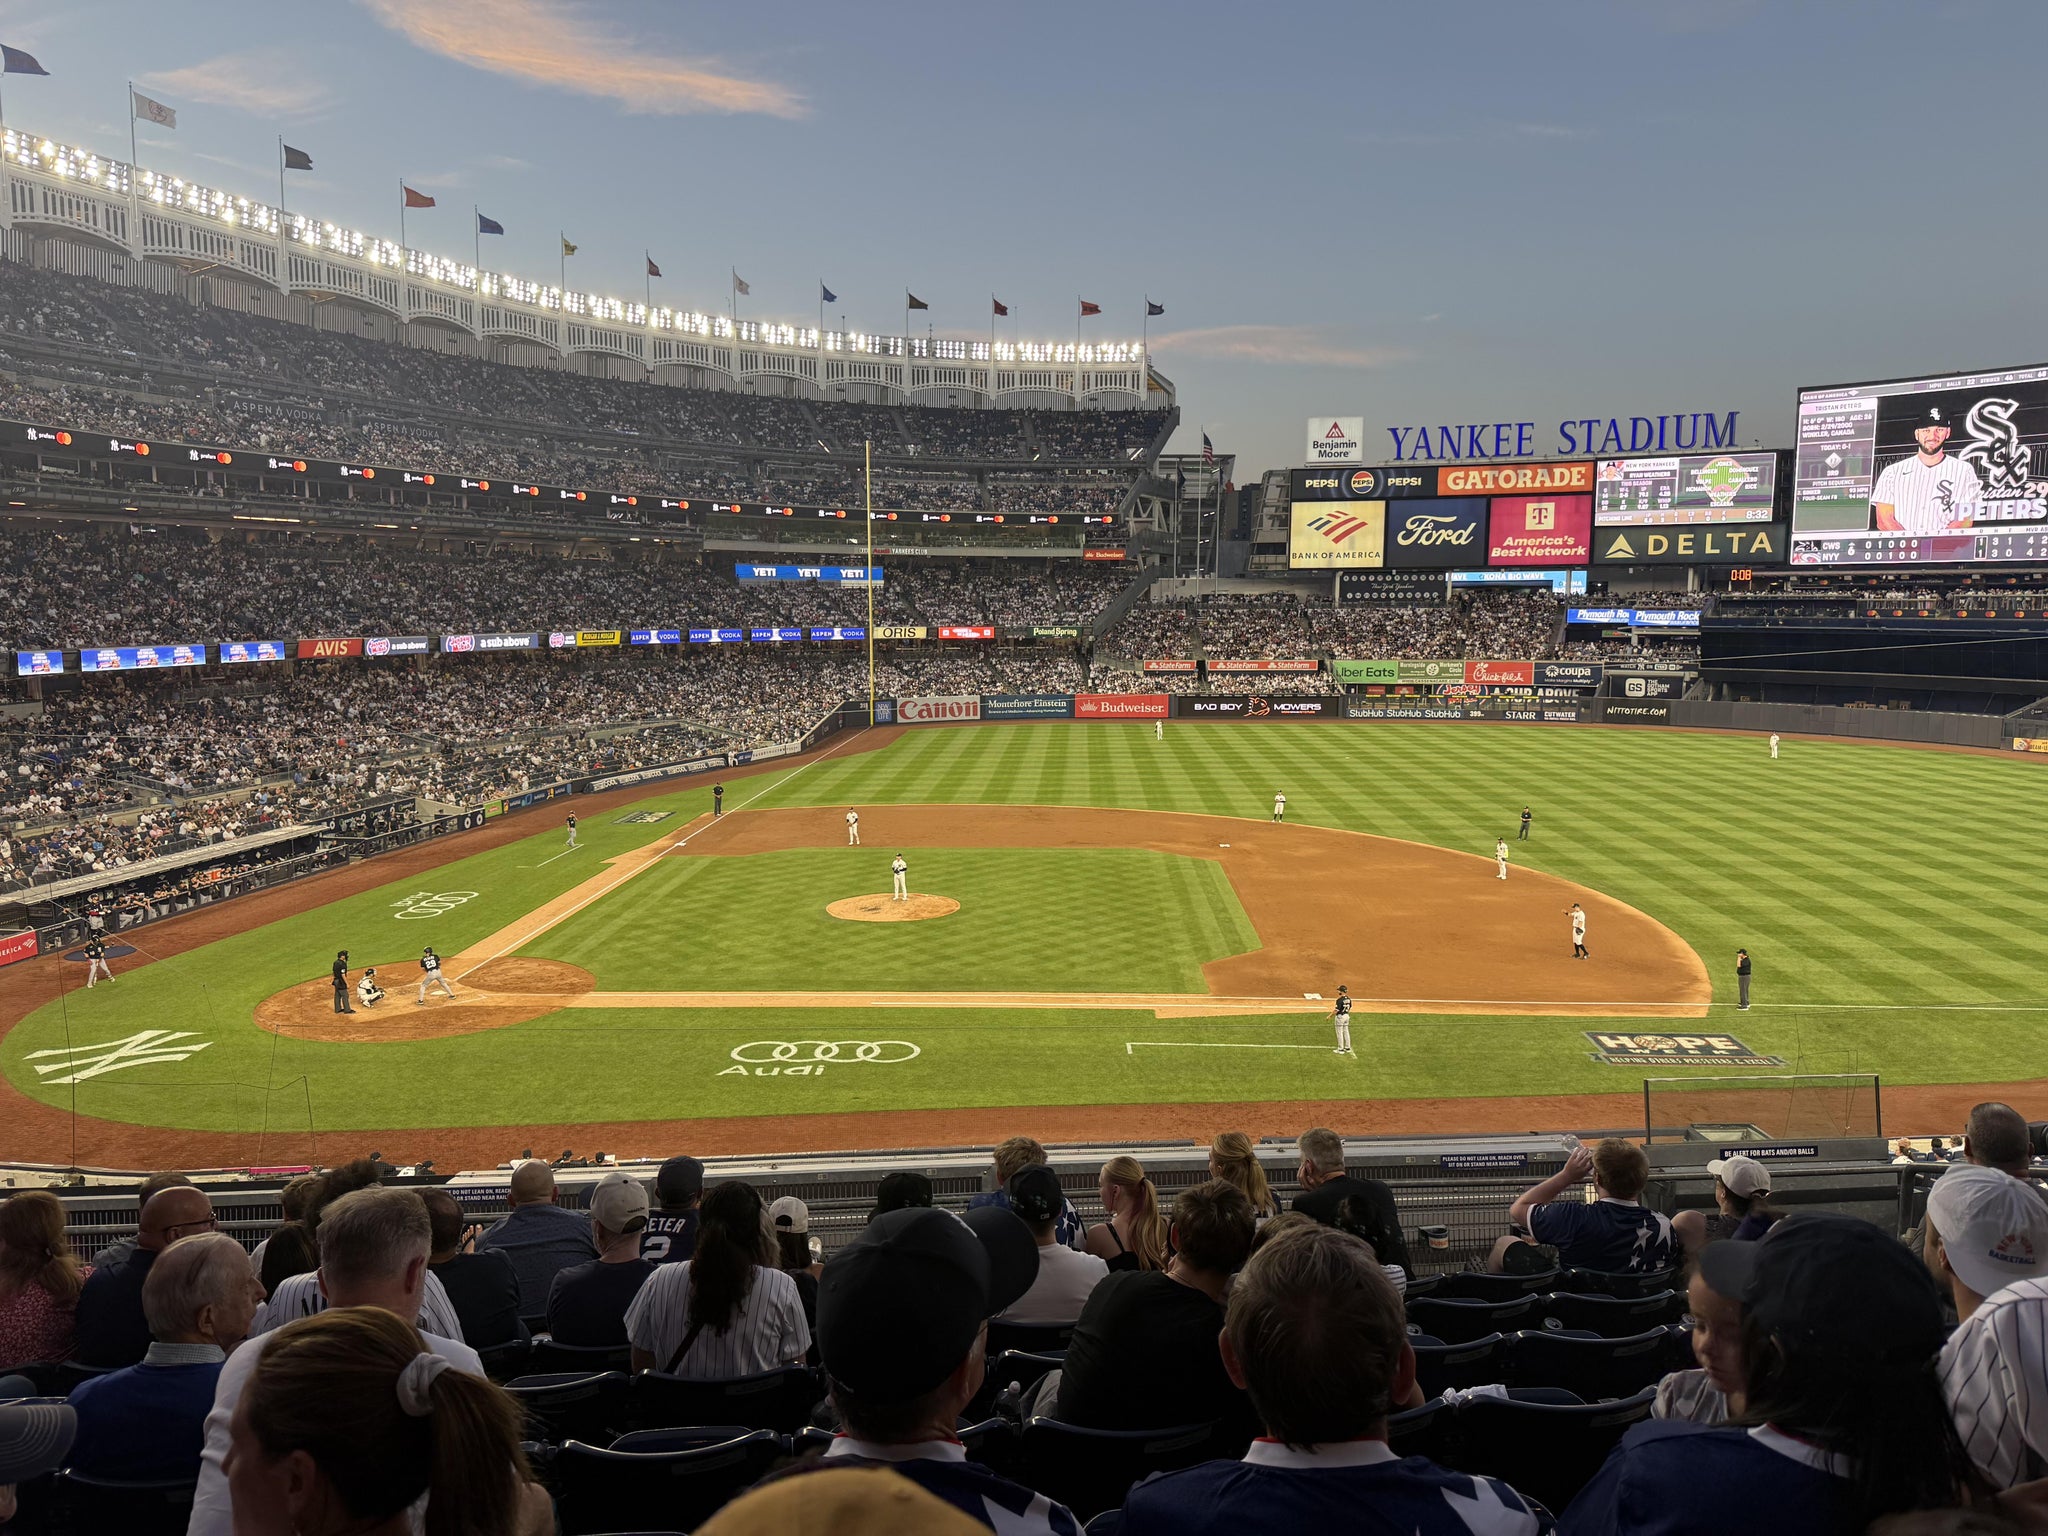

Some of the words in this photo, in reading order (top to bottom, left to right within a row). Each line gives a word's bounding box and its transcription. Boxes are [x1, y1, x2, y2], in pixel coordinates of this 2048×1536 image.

[368, 423, 398, 433] ASPEN
[410, 427, 440, 439] VODKA
[1387, 422, 1535, 461] YANKEE
[1557, 411, 1740, 454] STADIUM
[1312, 440, 1357, 450] Benjamin
[1318, 450, 1349, 458] Moore
[1305, 479, 1339, 488] PEPSI
[1387, 478, 1422, 486] PEPSI
[1447, 466, 1586, 491] GATORADE
[2024, 482, 2048, 498] 29
[1746, 510, 1768, 519] 8:32
[1956, 499, 2048, 521] PETERS
[1396, 514, 1476, 546] Ford
[1503, 536, 1575, 546] America's
[1647, 532, 1773, 556] DELTA
[1822, 542, 1840, 550] CWS
[1866, 541, 1872, 549] 0
[1888, 540, 1894, 548] 0
[1900, 540, 1906, 548] 0
[1992, 537, 1999, 545] 3
[2008, 537, 2012, 545] 1
[2027, 536, 2034, 544] 4
[2041, 536, 2048, 544] 2
[1291, 552, 1318, 560] BANK
[1321, 552, 1333, 560] OF
[1335, 551, 1381, 560] AMERICA
[1491, 547, 1524, 557] Best
[1525, 546, 1587, 556] Network
[1822, 553, 1839, 561] NYY
[1865, 552, 1871, 560] 0
[1899, 551, 1905, 559] 0
[1911, 551, 1917, 559] 0
[1992, 549, 1998, 557] 3
[2006, 549, 2012, 557] 0
[2026, 548, 2033, 556] 4
[2041, 548, 2047, 556] 2
[752, 567, 776, 577] YETI
[798, 568, 820, 578] YETI
[840, 569, 864, 578] YETI
[1731, 569, 1752, 580] 0:08
[1577, 610, 1615, 620] Plymouth
[1635, 611, 1676, 621] Plymouth
[1677, 611, 1700, 620] Rock
[883, 628, 916, 637] ORIS
[1034, 628, 1055, 636] Poland
[1056, 628, 1077, 636] Spring
[480, 640, 486, 648] a
[487, 638, 503, 647] sub
[504, 636, 529, 646] above
[314, 640, 348, 656] AVIS
[1366, 667, 1394, 677] Eats
[1560, 667, 1591, 678] coupa
[1443, 684, 1480, 695] Jersey
[1629, 683, 1642, 691] GS
[989, 700, 1032, 708] Montefiore
[1034, 699, 1067, 708] Einstein
[1100, 702, 1164, 713] Budweiser
[899, 700, 978, 720] Canon
[1425, 710, 1461, 718] StubHub
[1506, 711, 1536, 719] STARR
[1607, 706, 1667, 717] NITTOTIRE.COM
[425, 960, 437, 969] 29
[716, 1065, 825, 1076] Audi
[641, 1236, 671, 1266] 2
[1988, 1249, 2036, 1264] BASKETBALL
